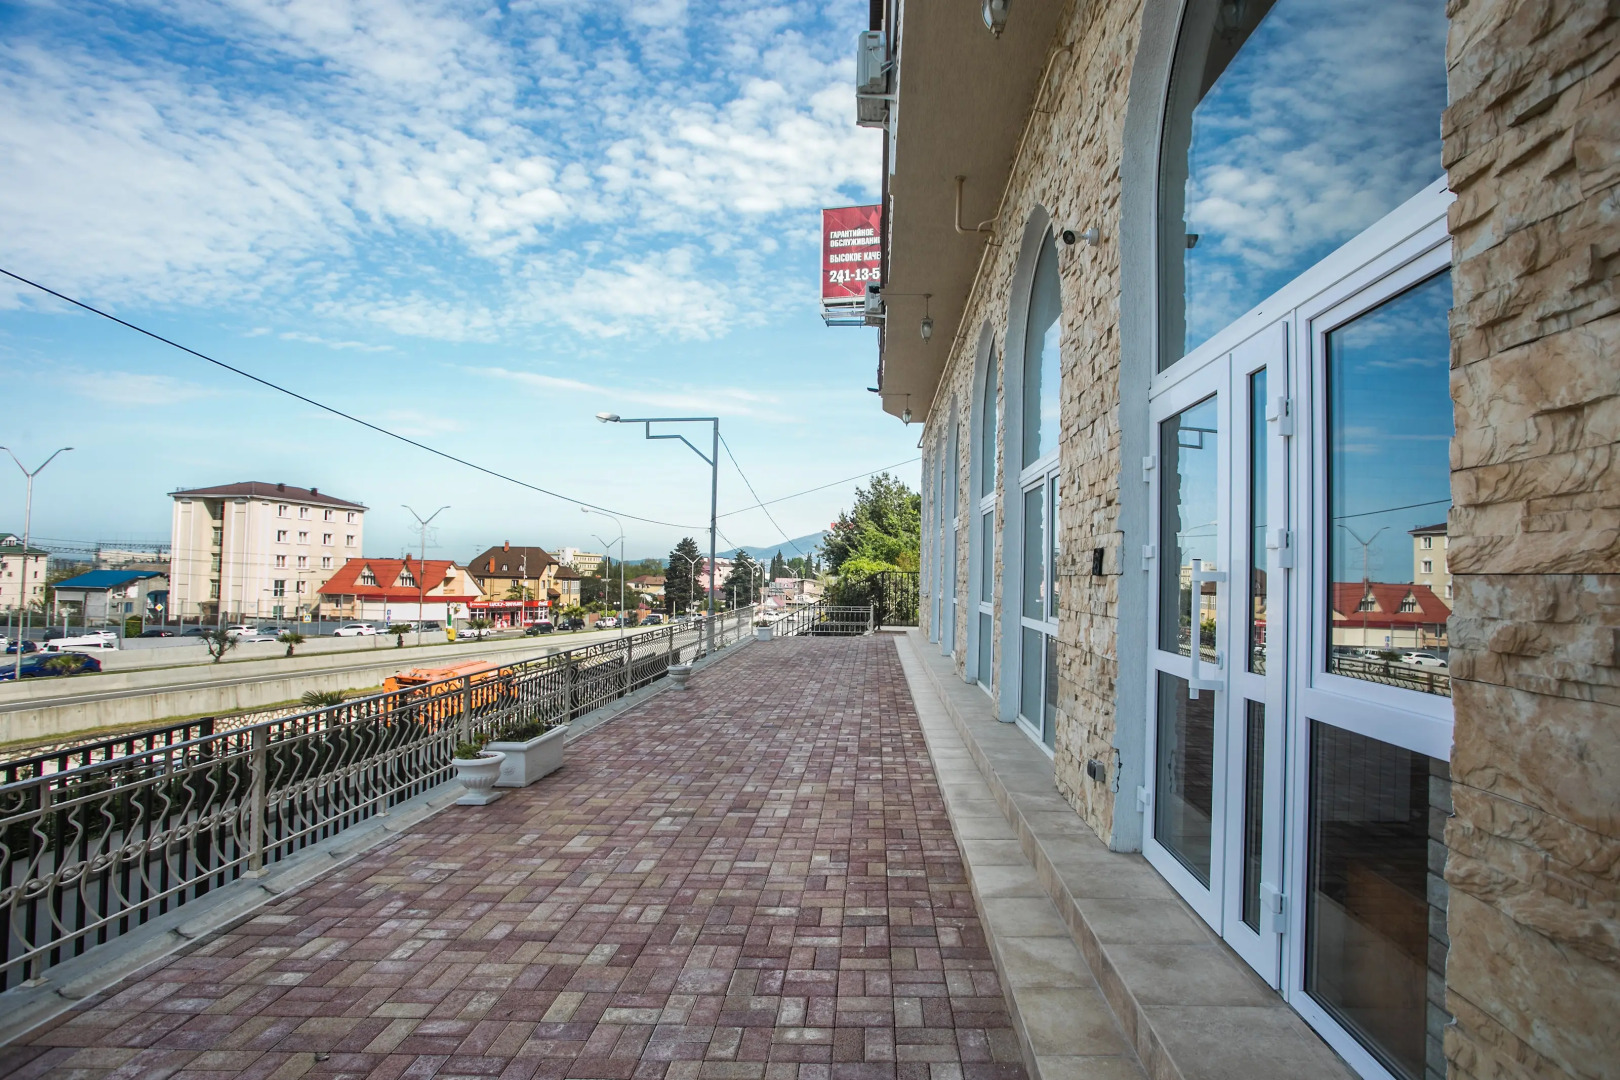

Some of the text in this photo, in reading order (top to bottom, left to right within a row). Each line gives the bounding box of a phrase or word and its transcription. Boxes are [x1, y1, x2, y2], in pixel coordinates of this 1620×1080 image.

[830, 228, 874, 239] ГАРАНТИЙНОЕ
[830, 251, 881, 263] ВЫСОКОЕ КАЧЕ
[829, 267, 880, 283] 241-13-5
